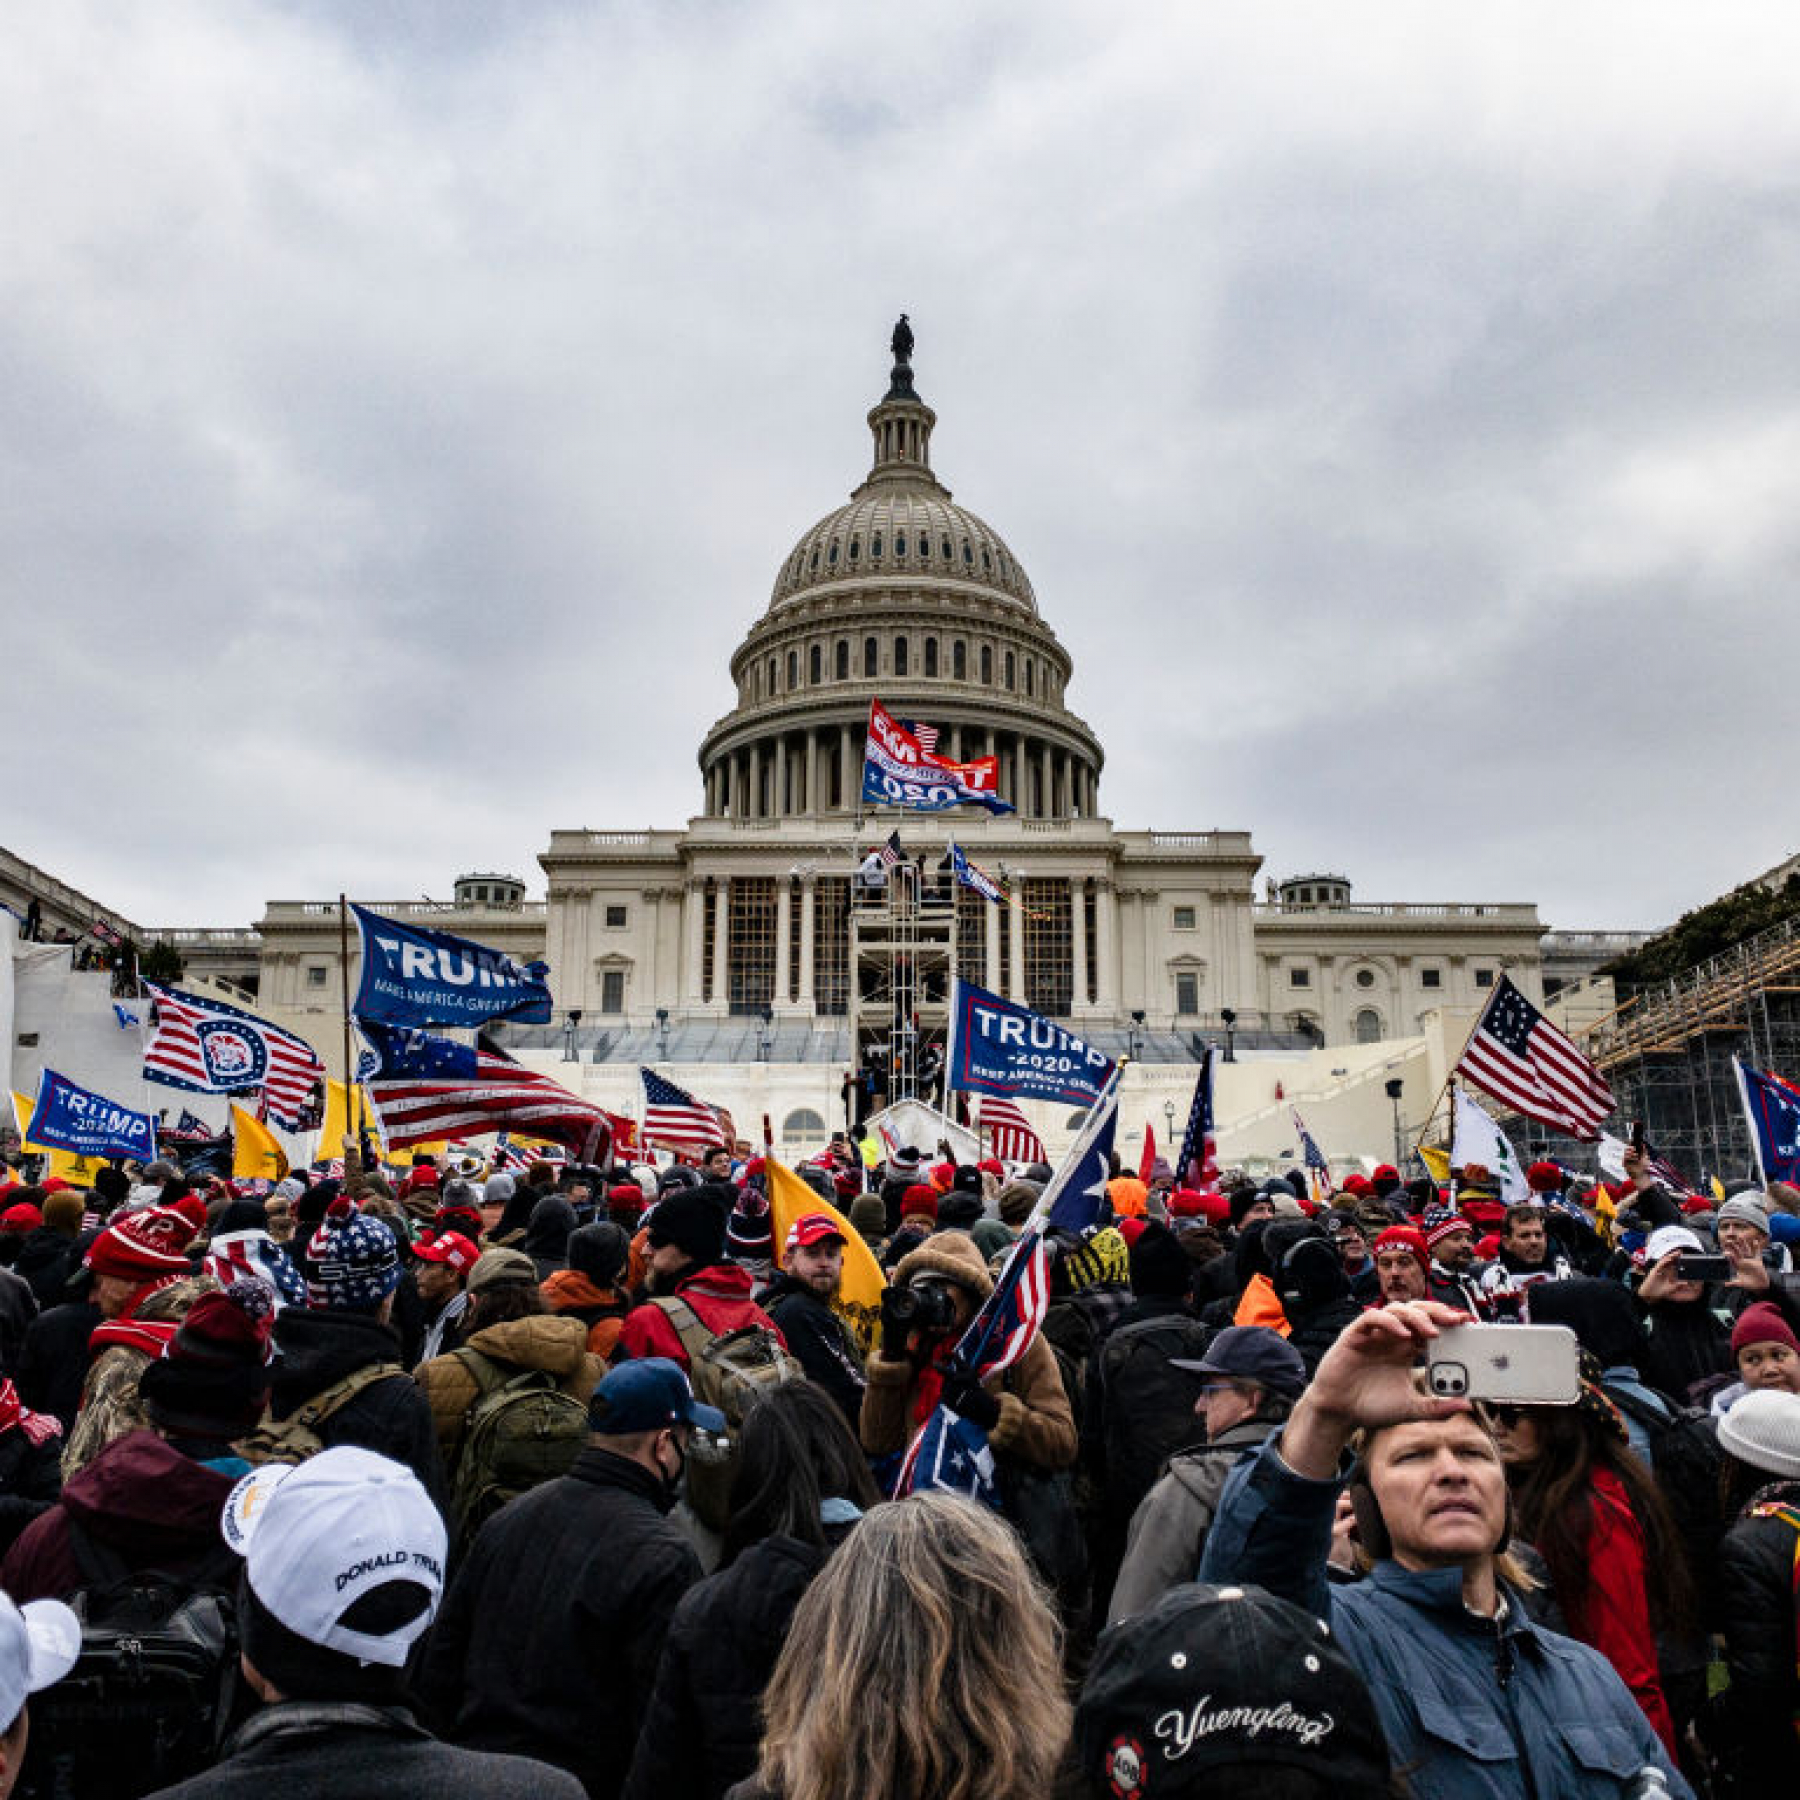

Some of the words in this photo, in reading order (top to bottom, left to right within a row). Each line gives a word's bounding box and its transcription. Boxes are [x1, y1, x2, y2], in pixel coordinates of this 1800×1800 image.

[407, 986, 465, 1010] AMERICA
[334, 1550, 408, 1592] DONALD
[1154, 1694, 1335, 1761] Yuengling
